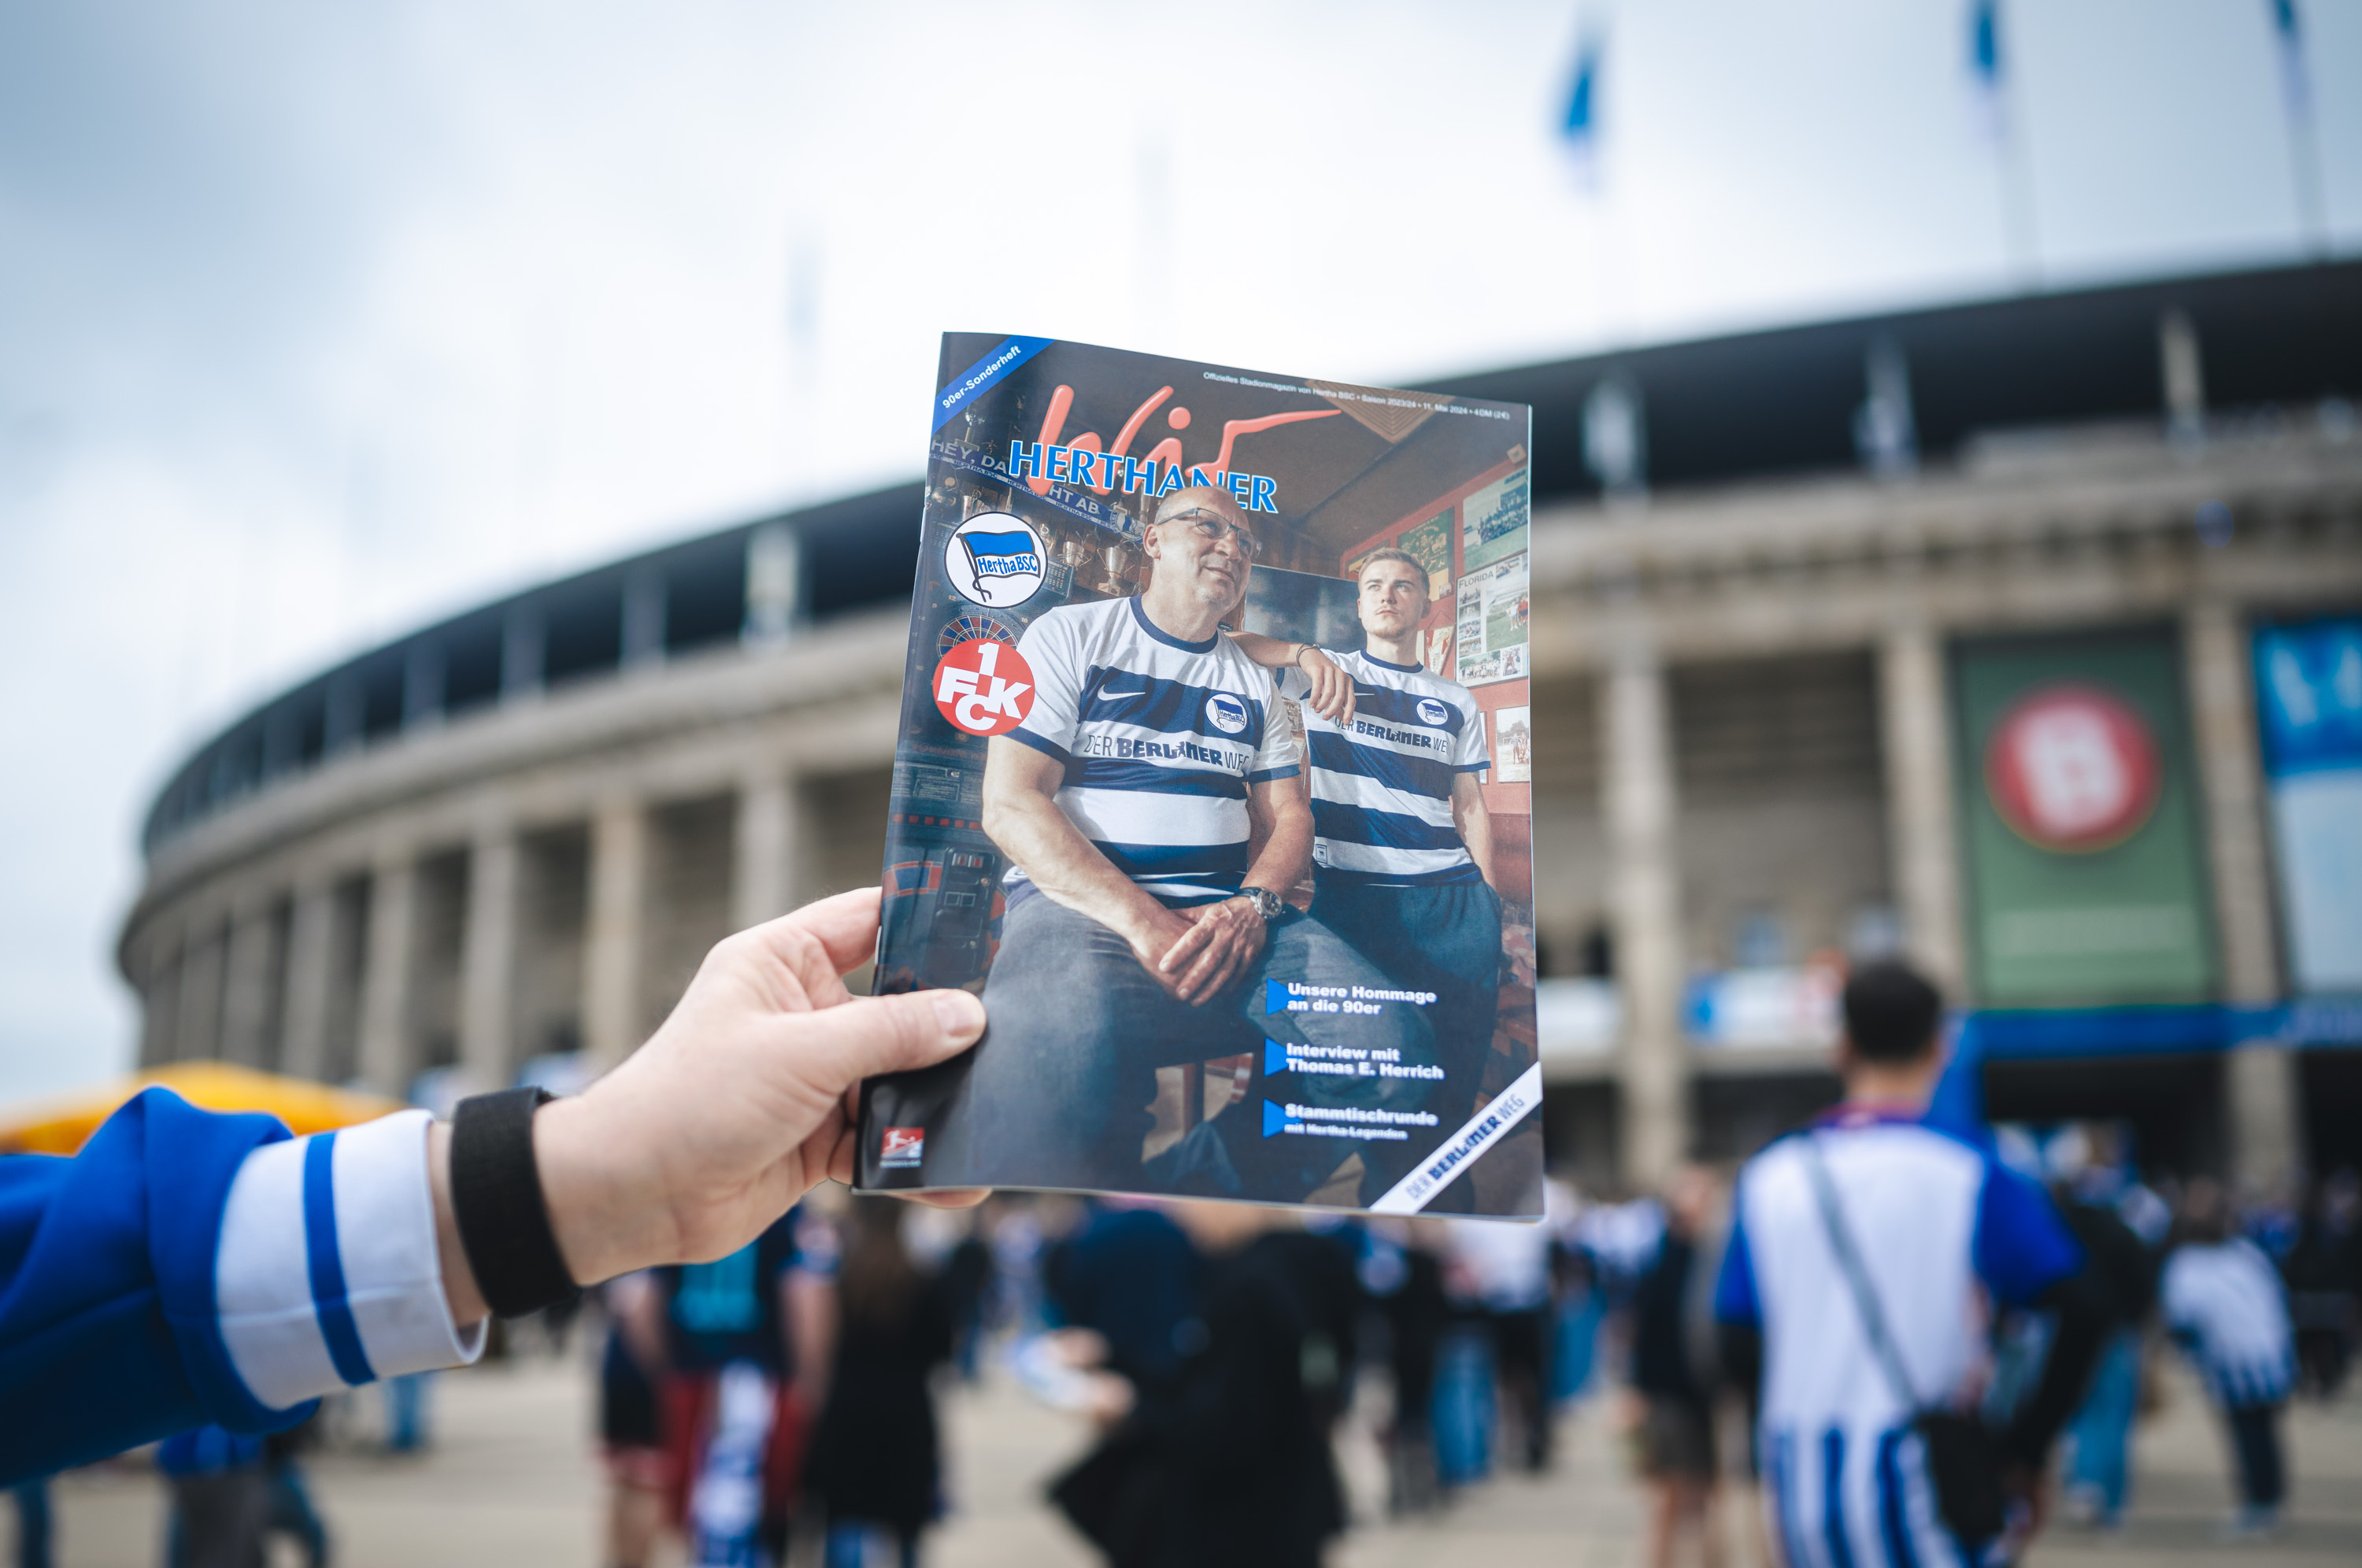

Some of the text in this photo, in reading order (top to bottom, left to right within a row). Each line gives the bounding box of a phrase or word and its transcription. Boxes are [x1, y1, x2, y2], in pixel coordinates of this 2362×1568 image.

[942, 345, 1022, 409] 90er-Sonderheft
[1203, 372, 1238, 384] Offizielles
[1239, 377, 1296, 392] Stadionmagazin
[1312, 388, 1337, 398] Hertha
[1338, 391, 1355, 401] BSC
[1361, 394, 1386, 405] Saison
[1435, 403, 1448, 412] Mai
[1449, 405, 1468, 415] 2024
[931, 439, 976, 464] HEY,
[981, 454, 1019, 479] DA
[1458, 571, 1494, 590] FLORIDA
[1083, 735, 1113, 756] DER
[1433, 737, 1449, 753] WE
[1287, 982, 1437, 1004] Unsere Hommage
[1287, 999, 1381, 1015] an die 90er
[1286, 1043, 1401, 1062] Interview mit
[1286, 1058, 1446, 1080] Thomas E. Herrich
[1285, 1103, 1439, 1126] Stammtischrunde
[1284, 1123, 1305, 1134] mit
[1405, 1174, 1431, 1200] DER
[1498, 1093, 1524, 1121] WEG
